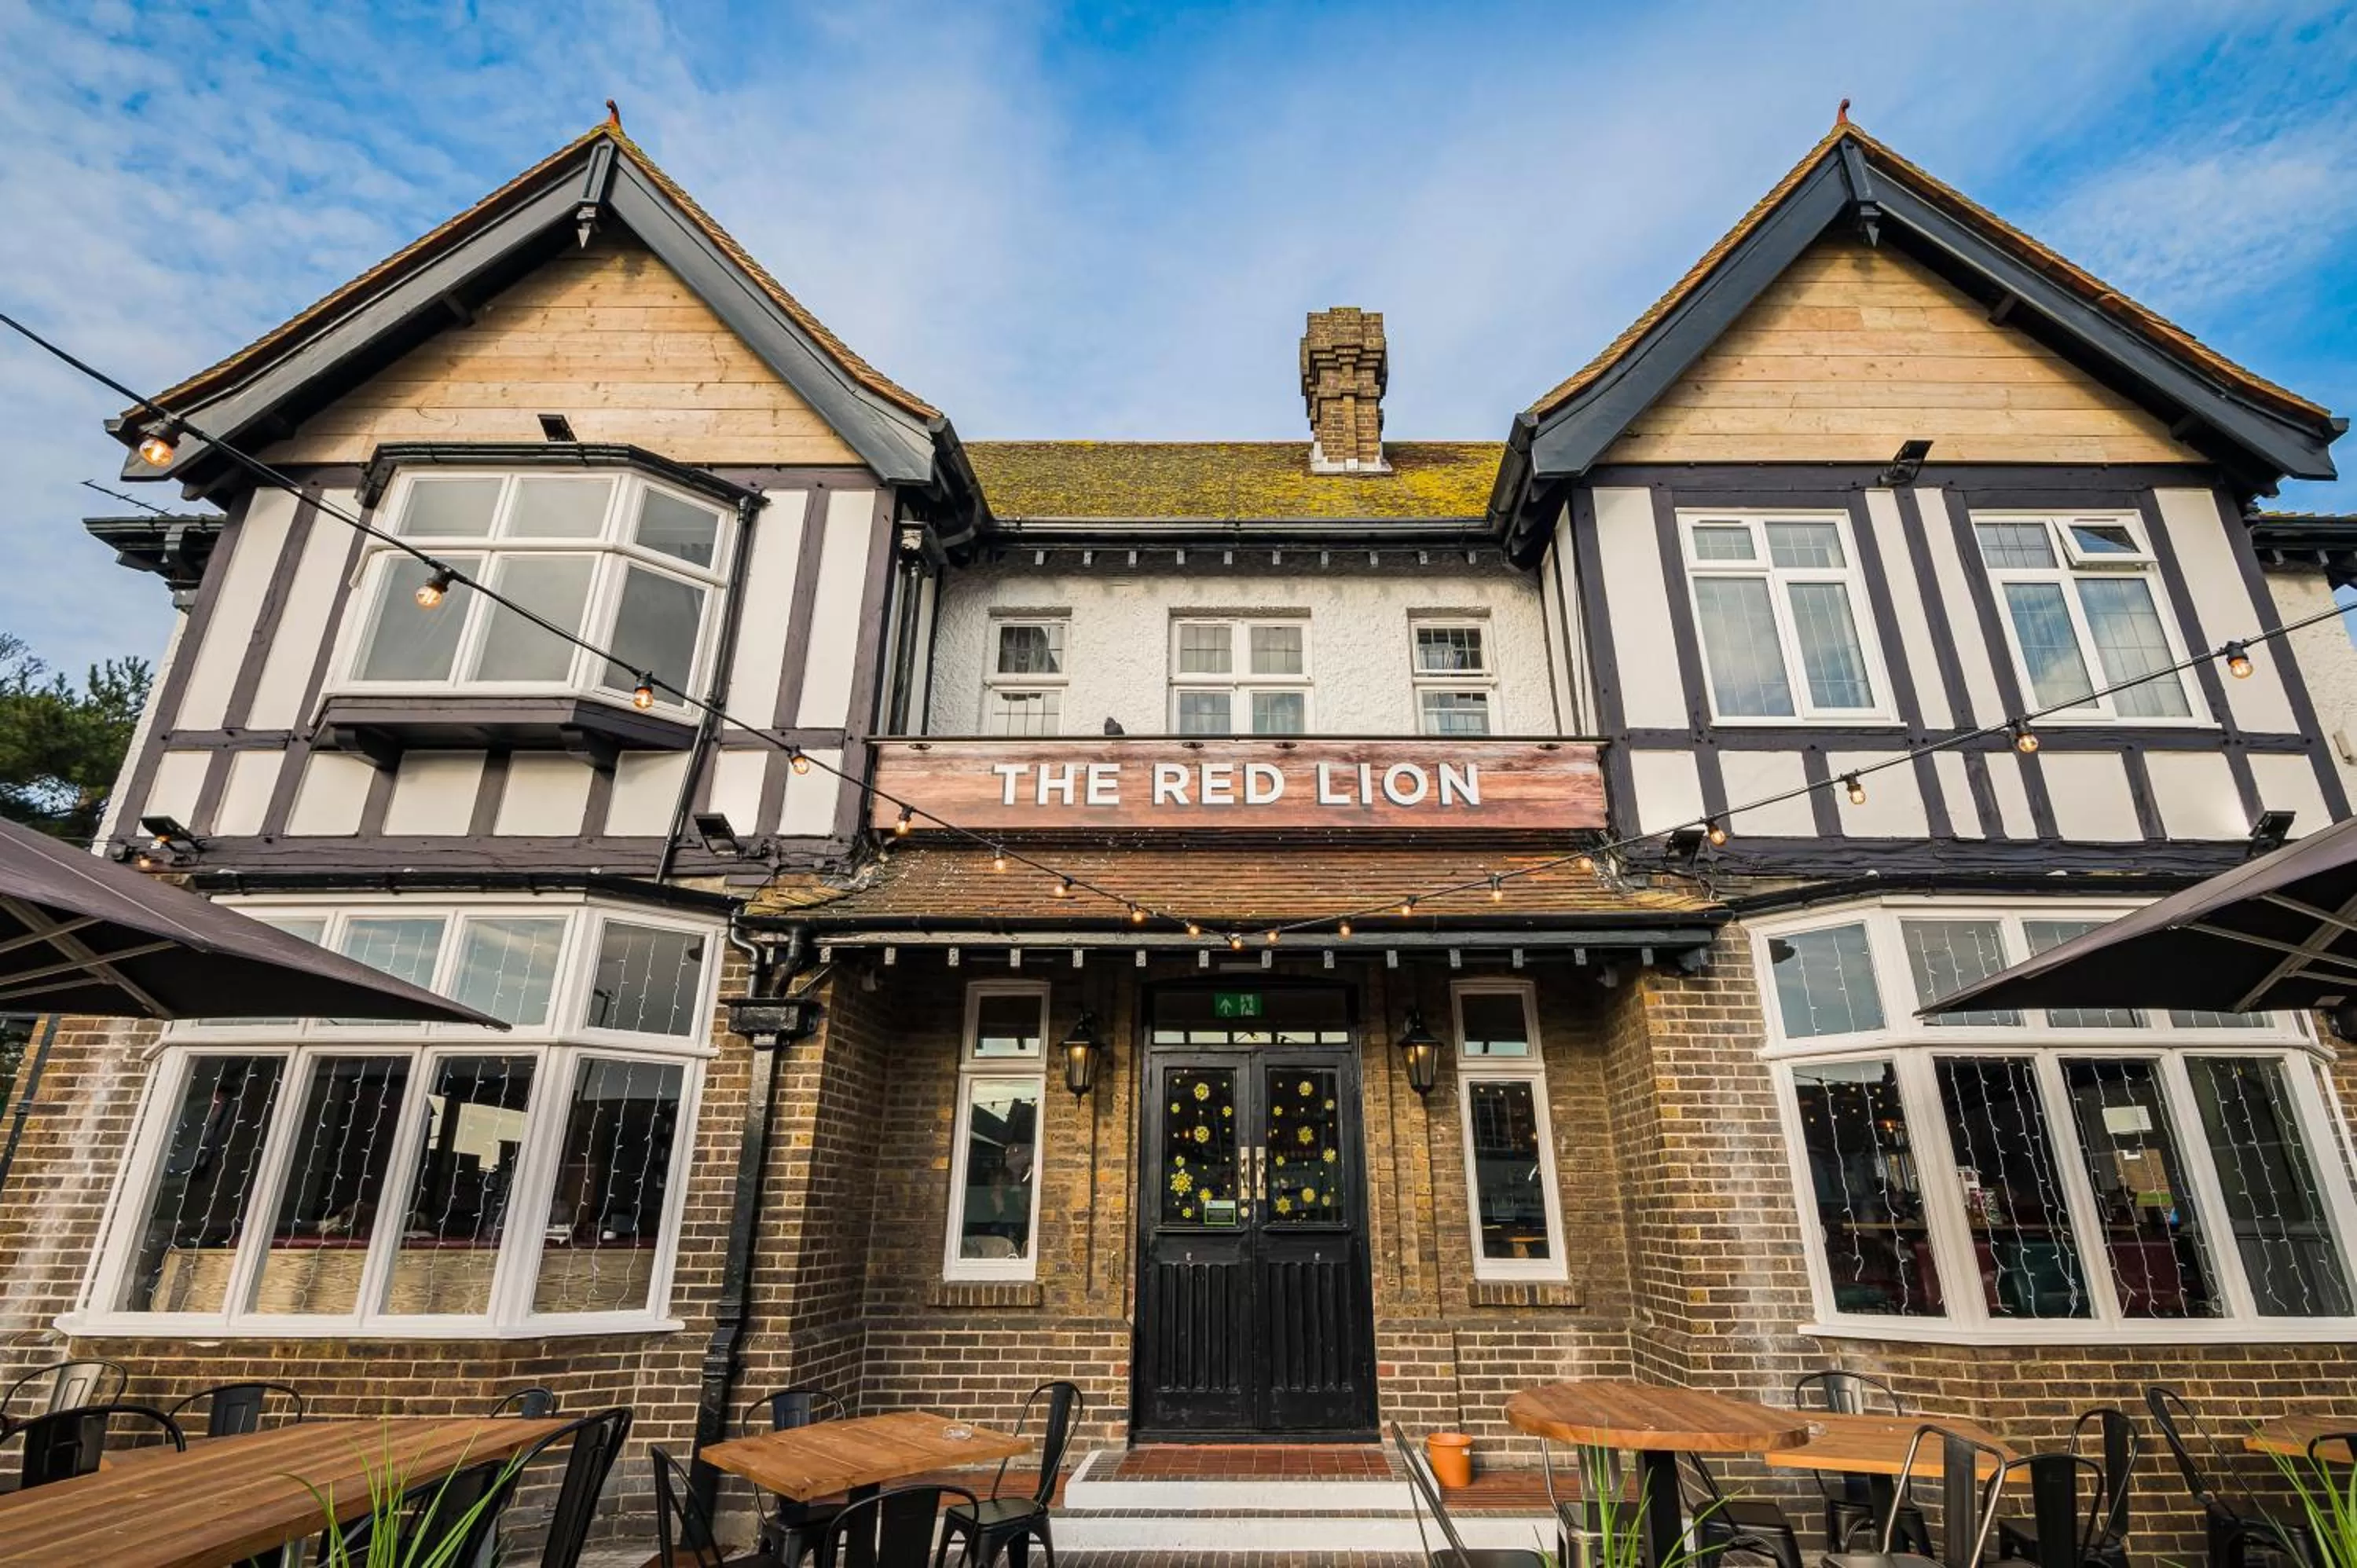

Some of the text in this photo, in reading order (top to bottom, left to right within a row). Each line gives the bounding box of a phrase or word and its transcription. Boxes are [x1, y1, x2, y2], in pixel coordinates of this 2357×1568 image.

[992, 761, 1482, 806] THE RED LION
